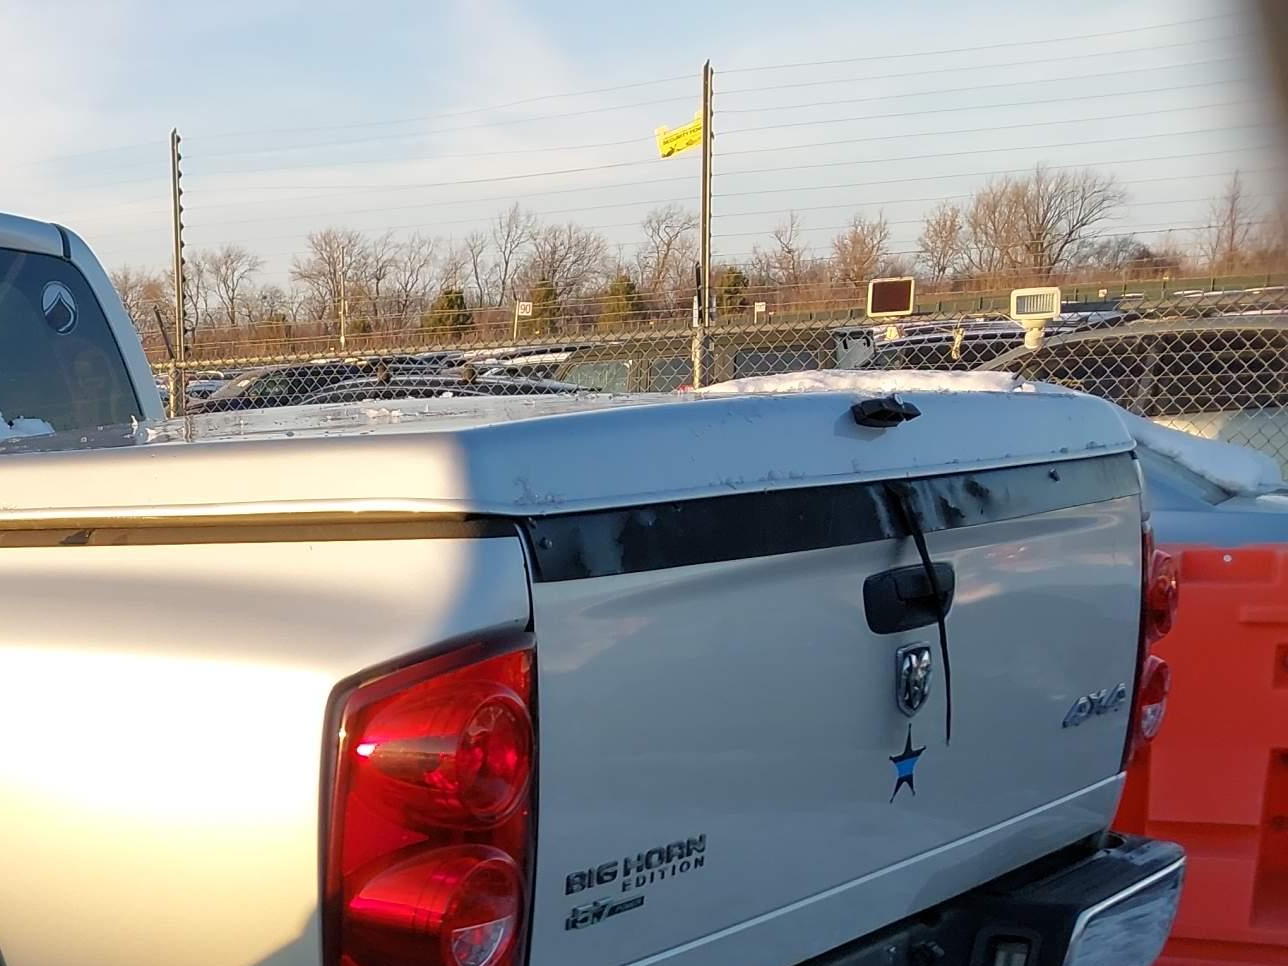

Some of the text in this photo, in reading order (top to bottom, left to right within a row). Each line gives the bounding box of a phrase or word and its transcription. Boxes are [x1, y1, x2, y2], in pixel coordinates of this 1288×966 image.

[521, 303, 531, 314] 90
[565, 833, 706, 896] BIG HORN
[621, 855, 705, 893] EDITION
